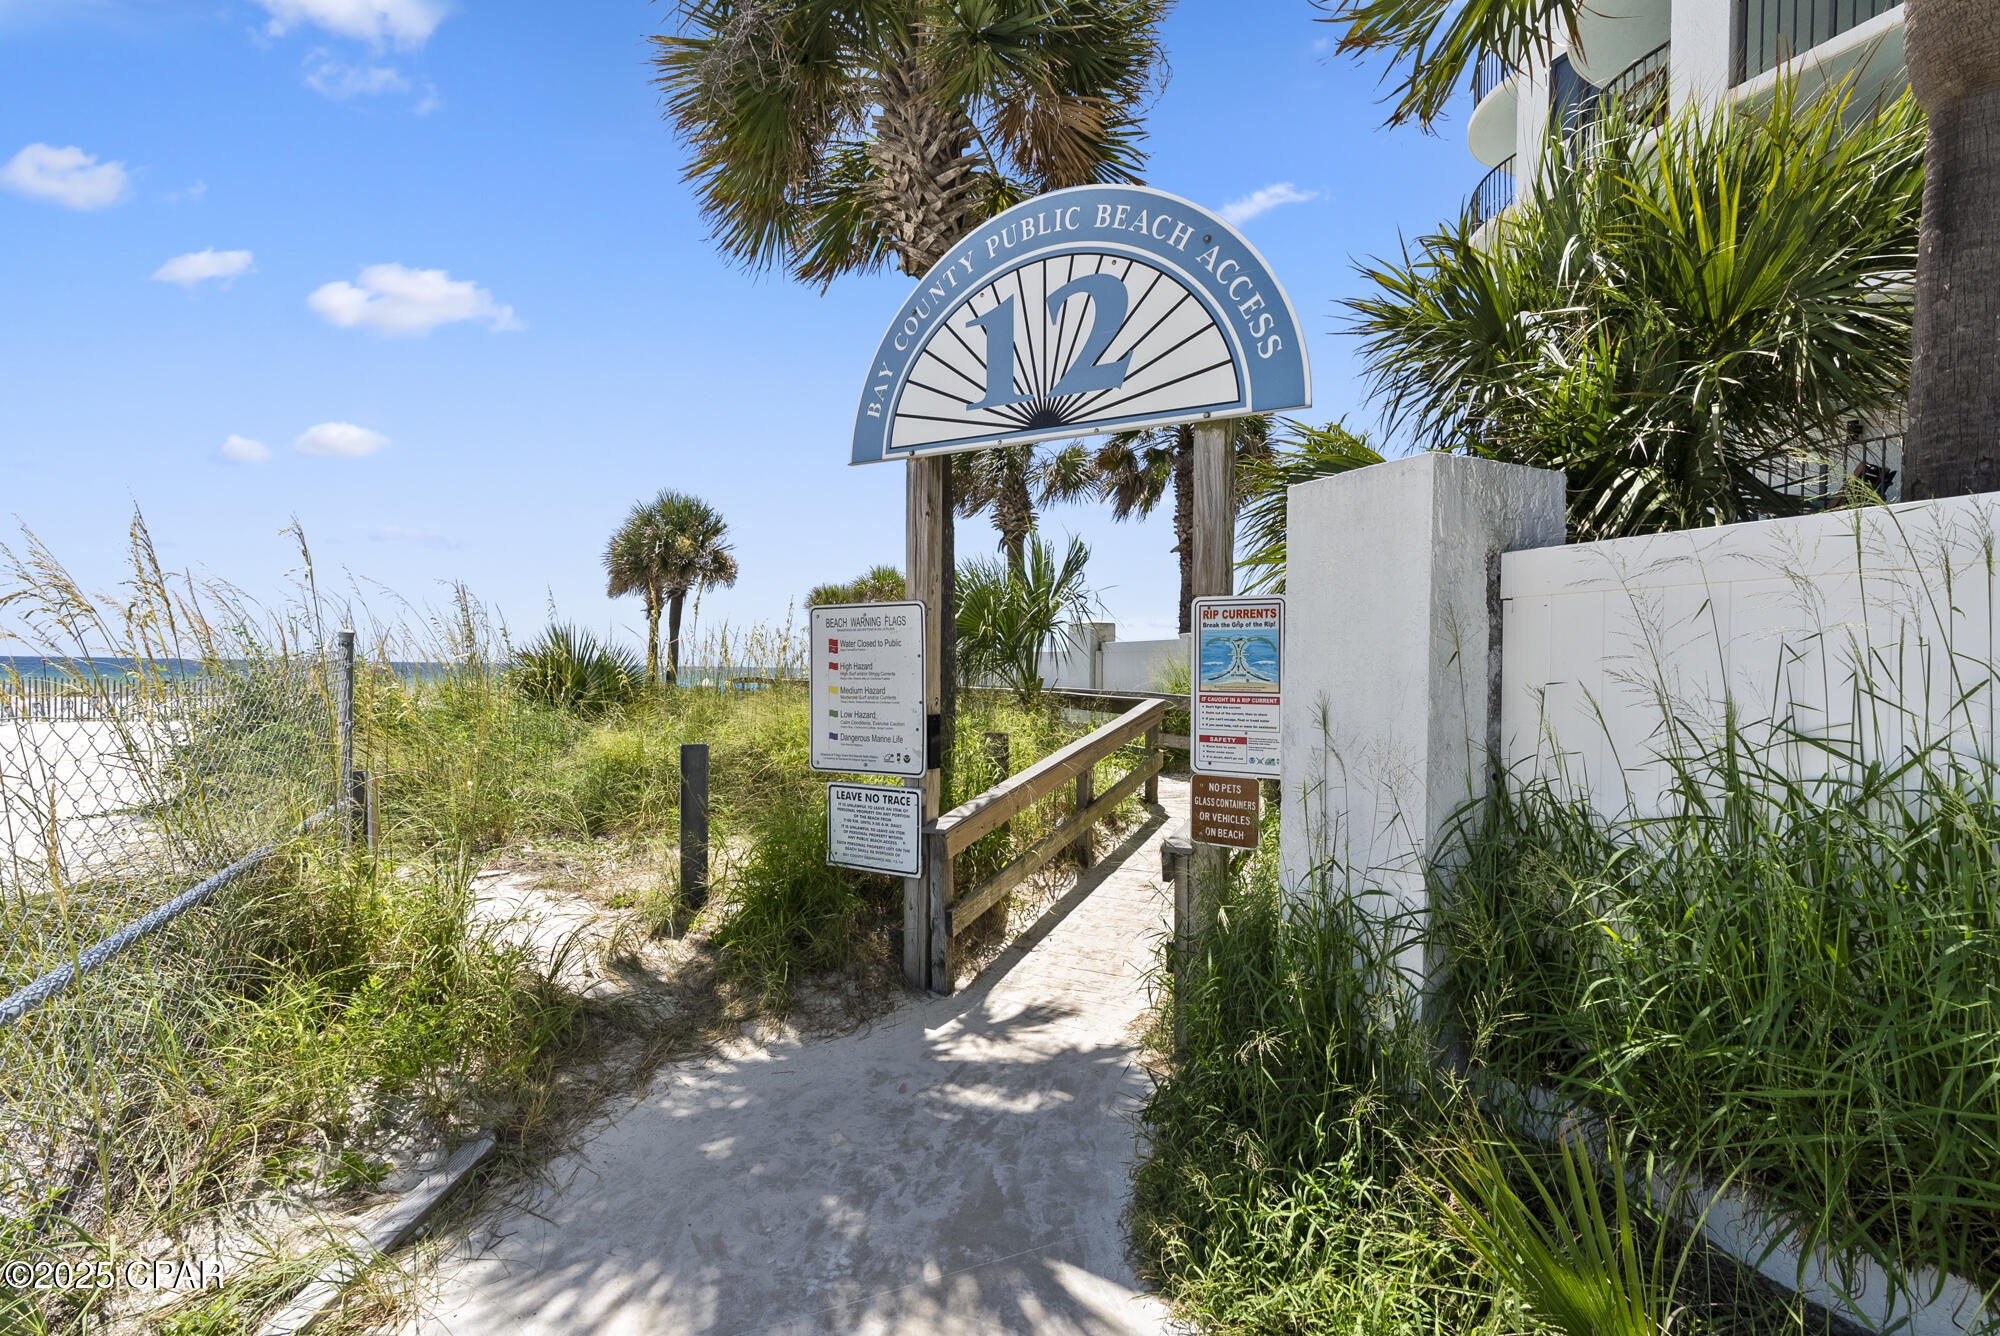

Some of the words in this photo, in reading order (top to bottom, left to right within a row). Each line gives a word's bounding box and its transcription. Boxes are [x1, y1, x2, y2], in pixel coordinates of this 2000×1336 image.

[866, 360, 894, 419] BAY
[894, 252, 975, 352] COUNTY
[984, 206, 1081, 260] PUBLIC
[1094, 204, 1196, 252] BEACH
[1196, 245, 1282, 360] ACCESS
[965, 273, 1134, 412] 12
[1203, 610, 1219, 619] RIP
[1222, 608, 1276, 618] CURRENTS
[826, 618, 847, 628] BEACH
[851, 617, 881, 627] WARNING
[885, 616, 906, 626] FLAGS
[840, 662, 852, 672] High
[841, 733, 870, 743] Dangerous
[872, 735, 891, 743] Marine
[1209, 782, 1219, 792] NO
[1222, 784, 1241, 793] PETS
[837, 791, 862, 801] LEAVE
[865, 794, 879, 803] NO
[883, 795, 910, 806] TRACE
[1195, 796, 1214, 806] GLASS
[1216, 799, 1256, 810] CONTAINERS
[1200, 812, 1209, 821] OR
[1212, 813, 1250, 825] VEHICLES
[1205, 827, 1216, 836] ON
[1218, 829, 1244, 840] BEACH
